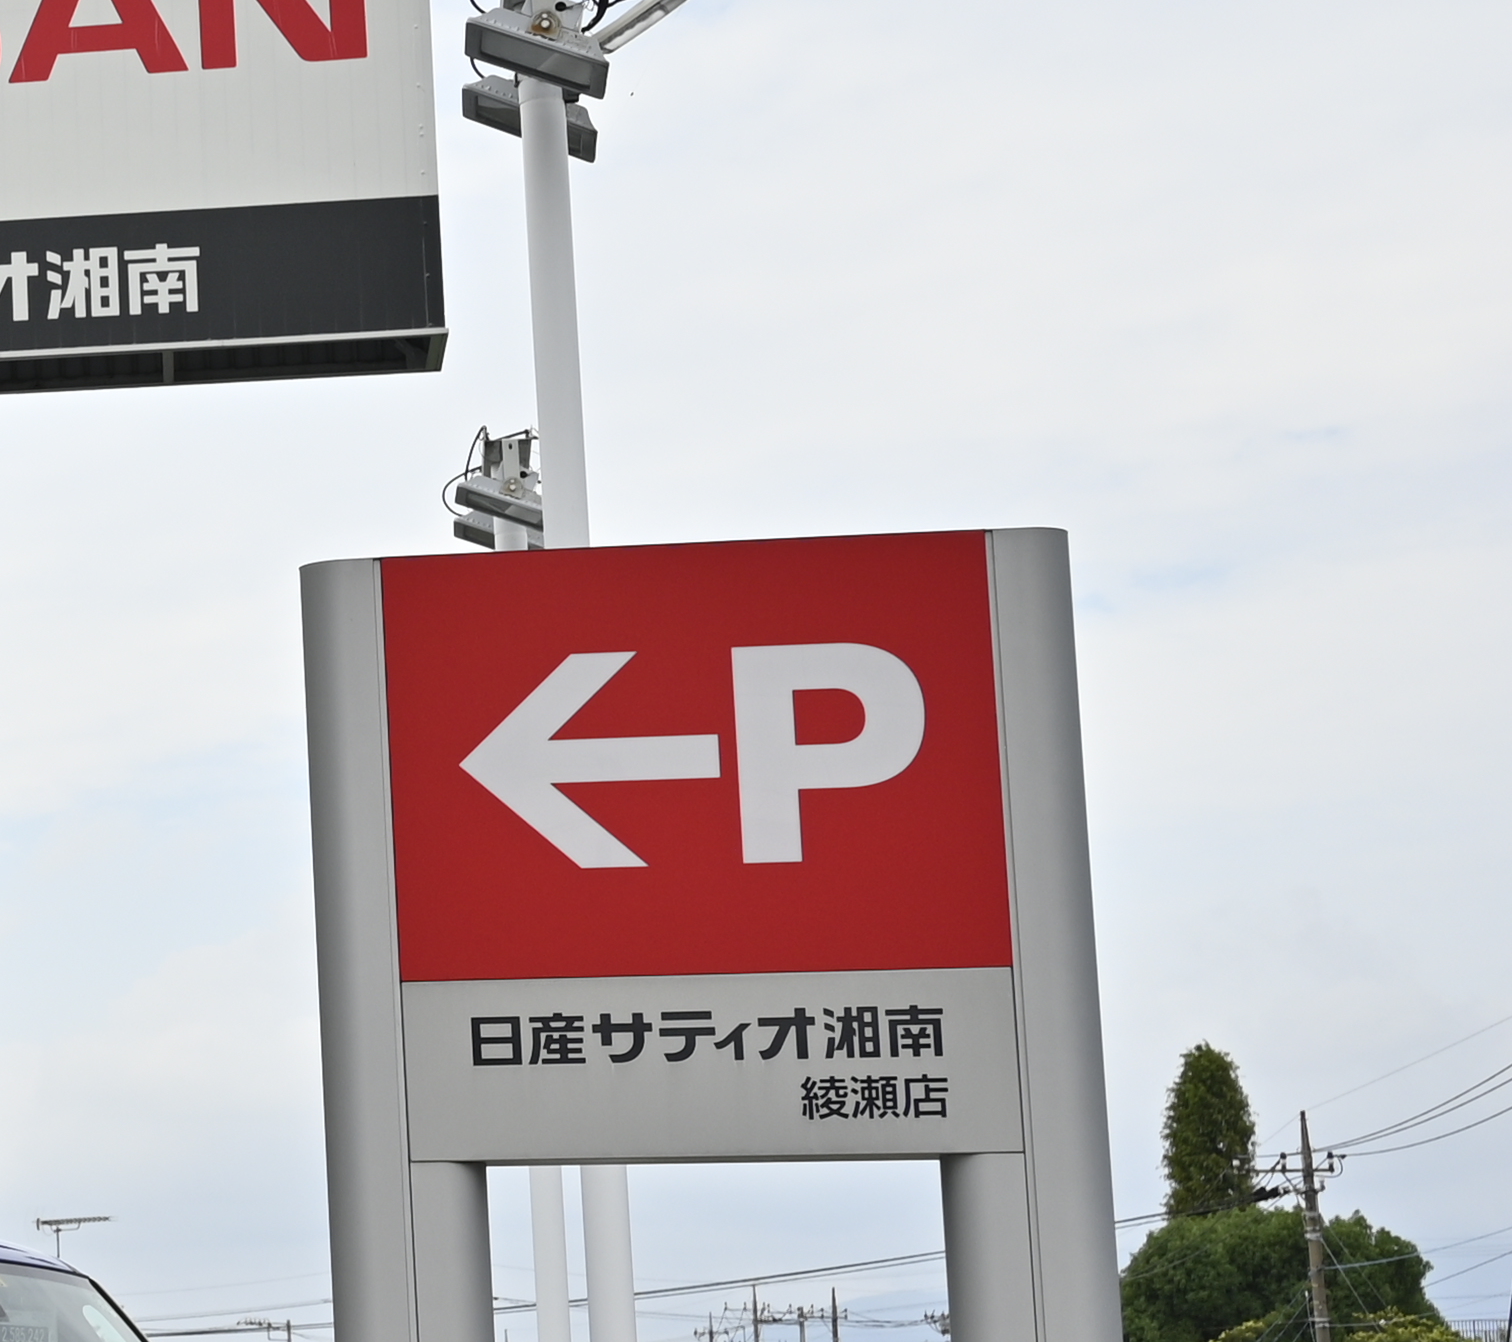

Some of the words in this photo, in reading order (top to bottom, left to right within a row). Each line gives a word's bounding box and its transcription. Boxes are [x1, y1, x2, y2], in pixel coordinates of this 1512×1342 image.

[731, 643, 925, 864] P
[469, 1004, 945, 1067] 日産サティオ湘南
[800, 1073, 949, 1120] 綾瀬店
